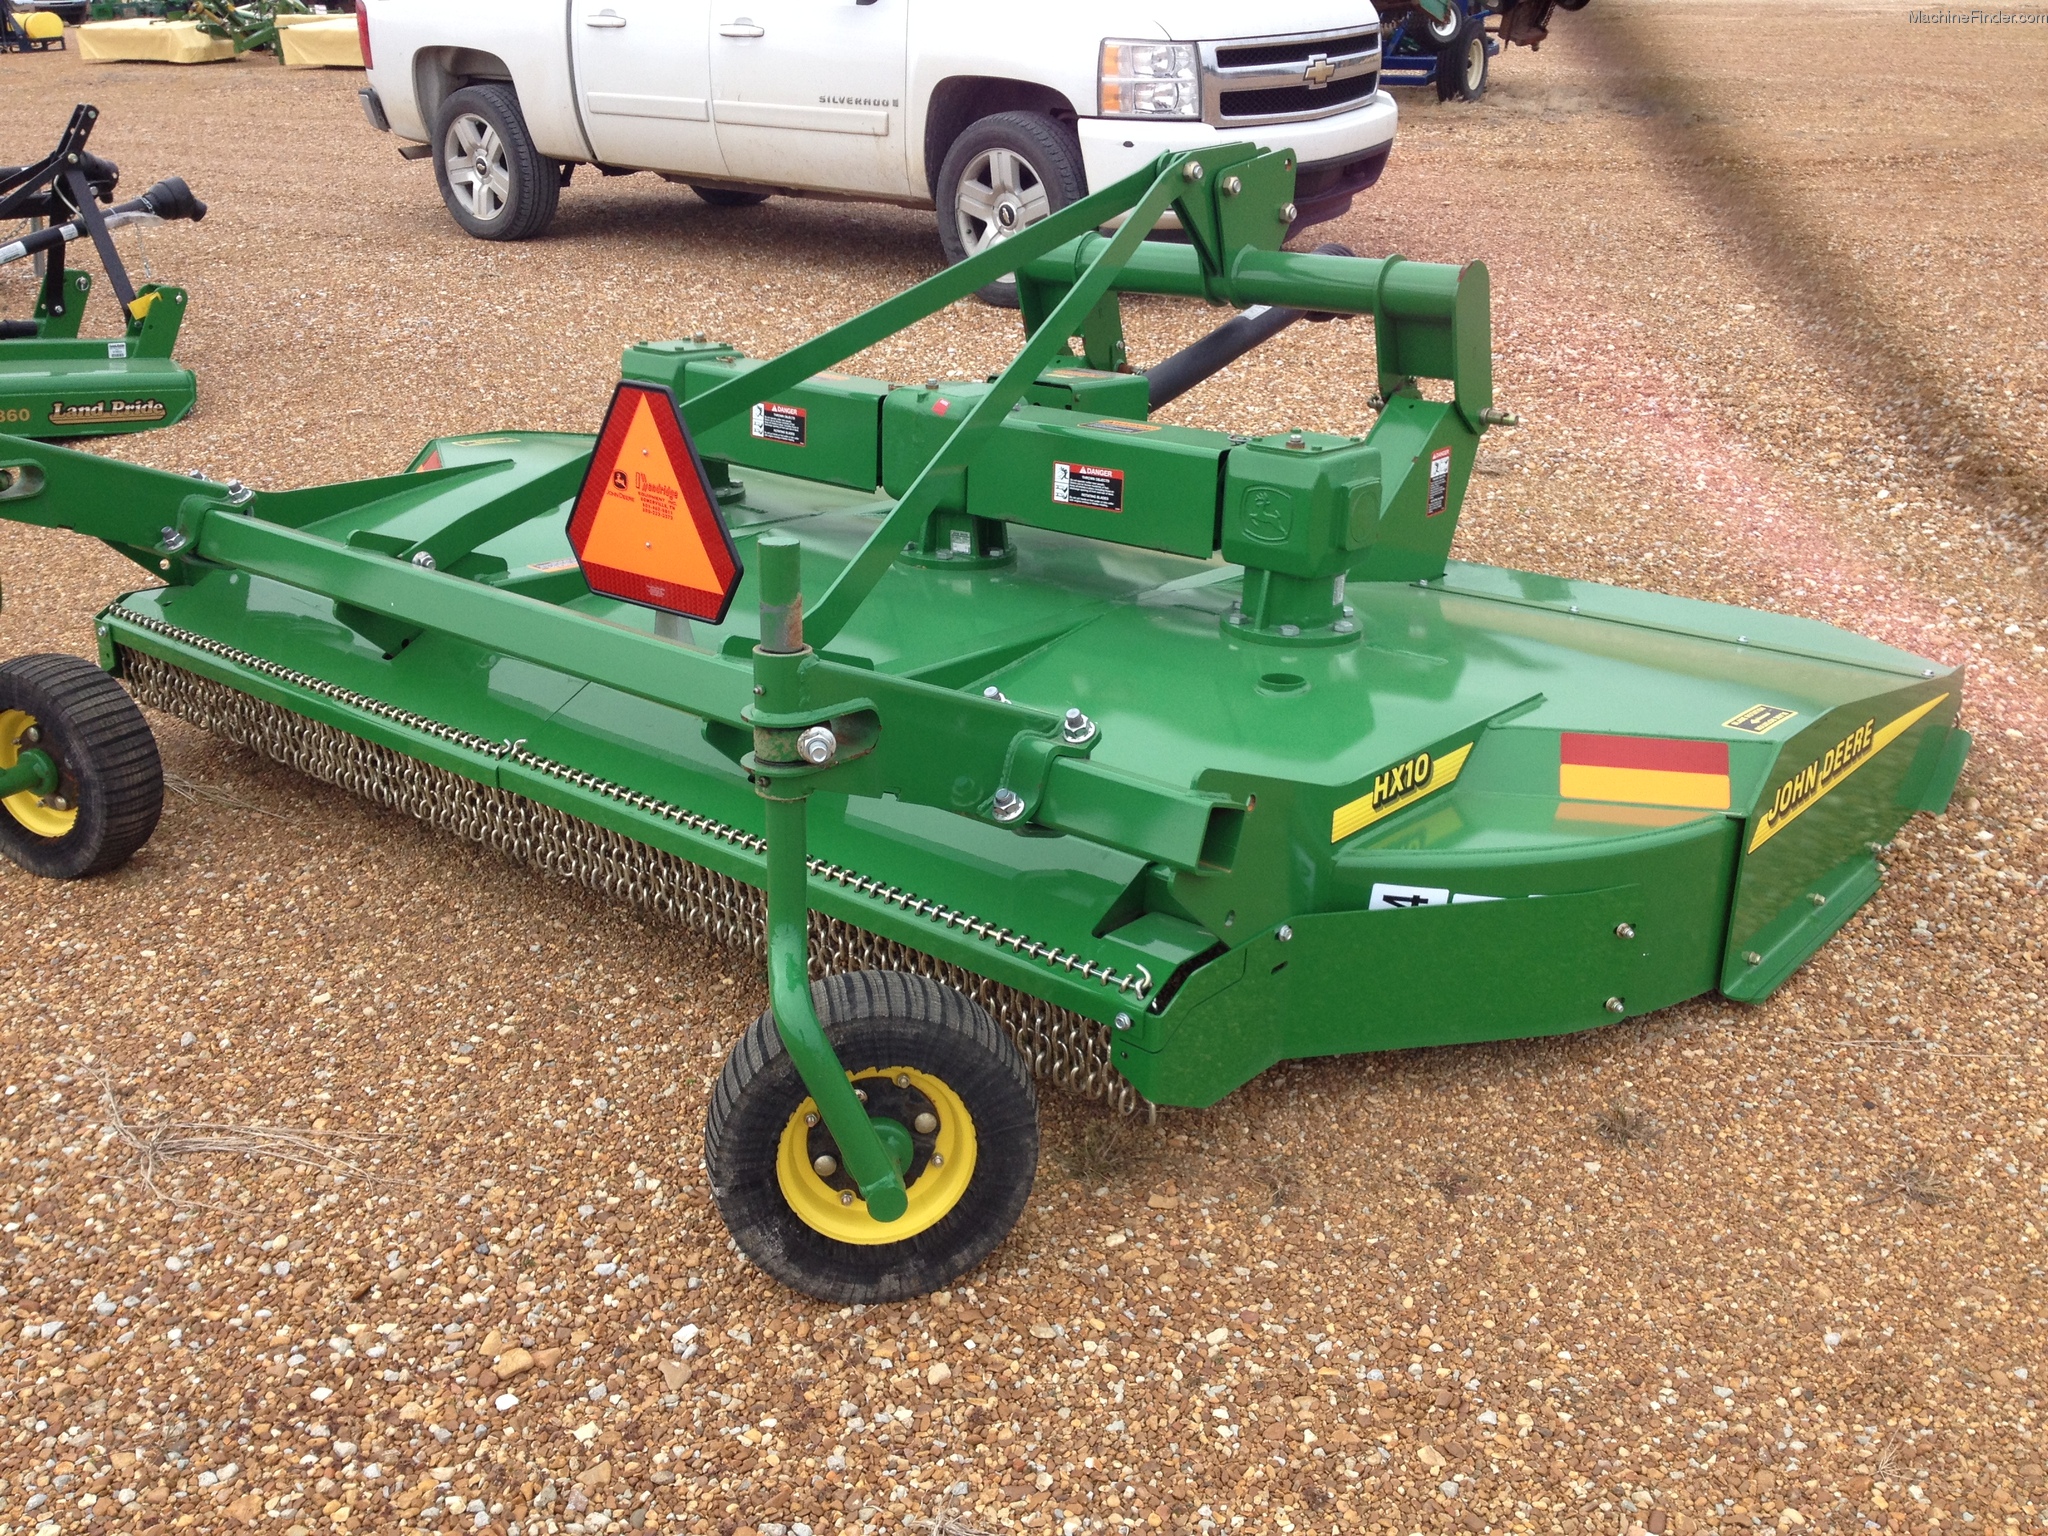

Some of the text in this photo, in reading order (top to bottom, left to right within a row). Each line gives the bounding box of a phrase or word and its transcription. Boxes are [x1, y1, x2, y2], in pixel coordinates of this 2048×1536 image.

[52, 399, 164, 417] Land Pride
[777, 406, 798, 415] DANGER
[1086, 468, 1113, 477] DANGER
[1372, 752, 1432, 809] HX10
[1767, 717, 1875, 826] JOHN DEERE
